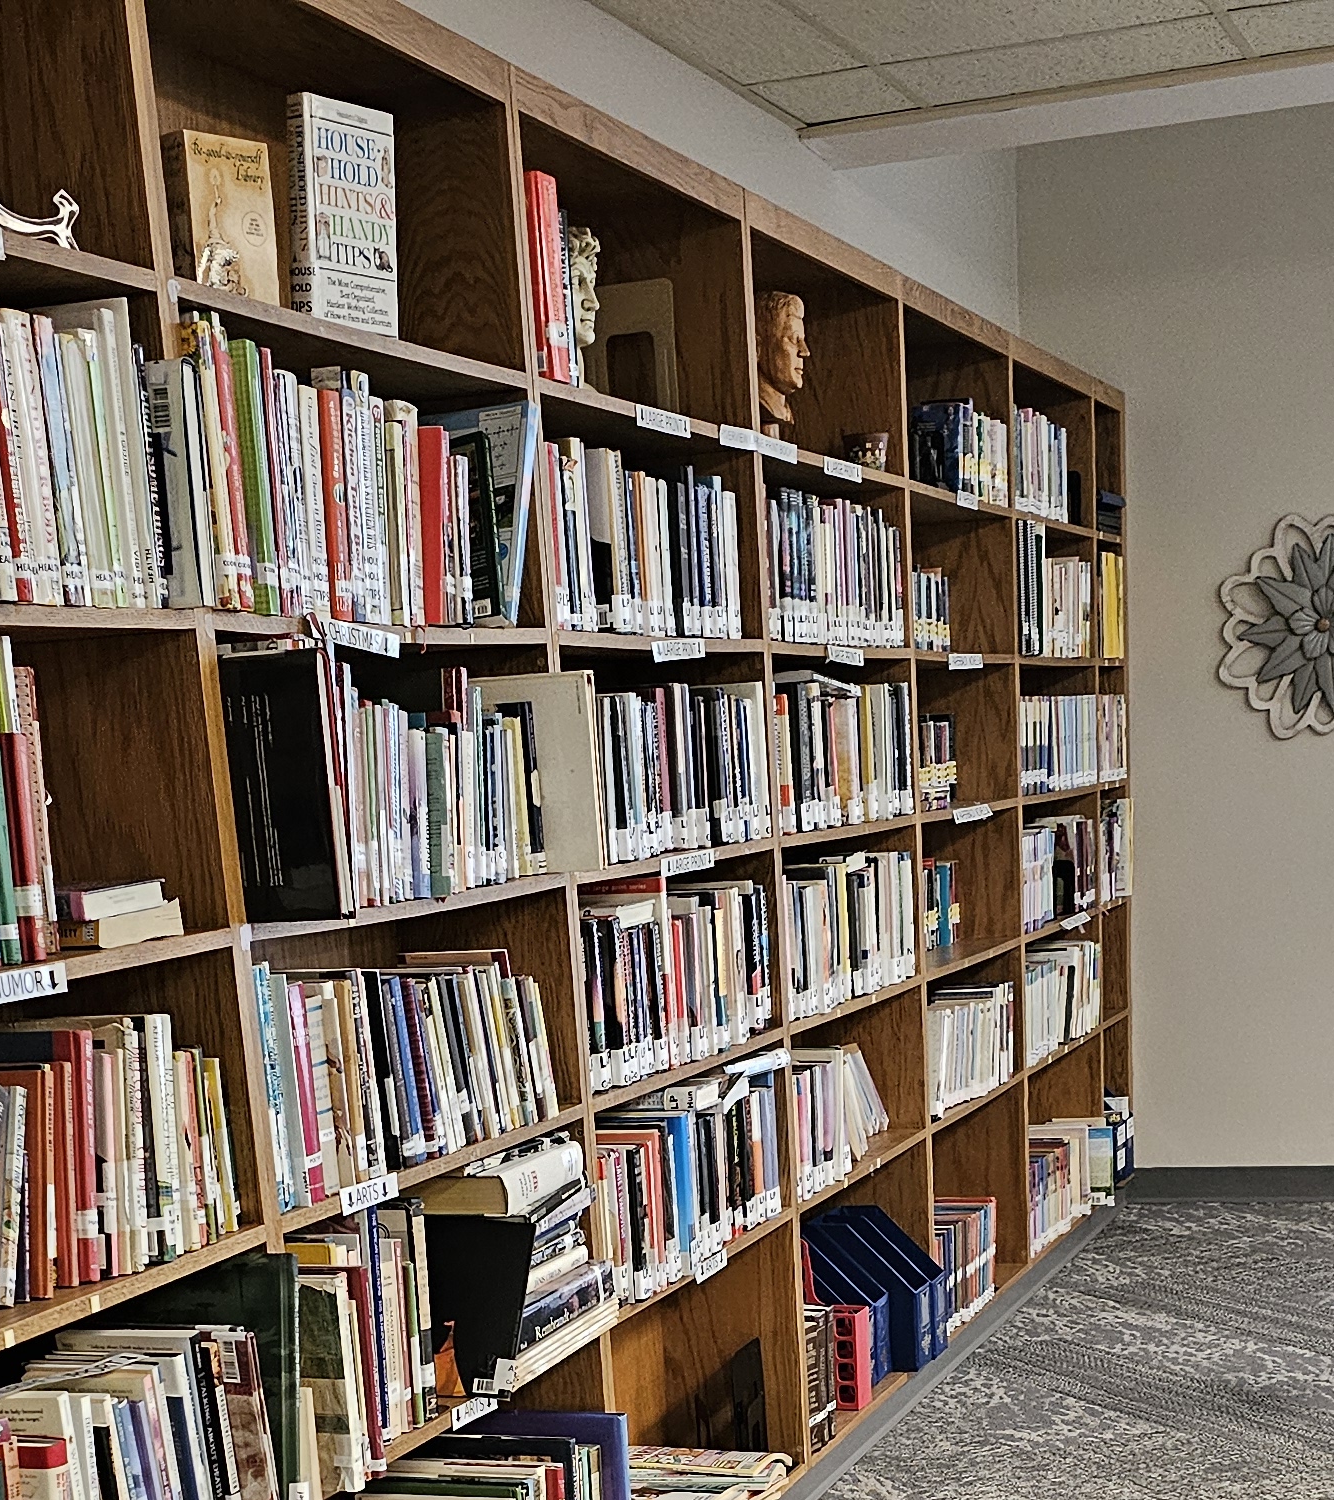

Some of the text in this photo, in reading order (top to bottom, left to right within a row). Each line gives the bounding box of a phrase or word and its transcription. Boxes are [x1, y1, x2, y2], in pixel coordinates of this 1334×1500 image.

[236, 163, 265, 190] Library
[330, 158, 378, 188] HOLD
[318, 183, 394, 220] HINTS &
[332, 214, 392, 246] HANDY
[332, 242, 372, 269] TIPS
[345, 412, 357, 477] Kitchen
[373, 422, 382, 459] Favorite
[376, 461, 384, 486] Foods
[349, 485, 360, 527] Table
[328, 622, 382, 653] CHRISTMAS
[670, 1095, 679, 1110] LP
[356, 1183, 380, 1206] ARTS
[464, 1399, 486, 1420] ARTS
[200, 1378, 223, 1497] TALKING ABOUT DEATH
